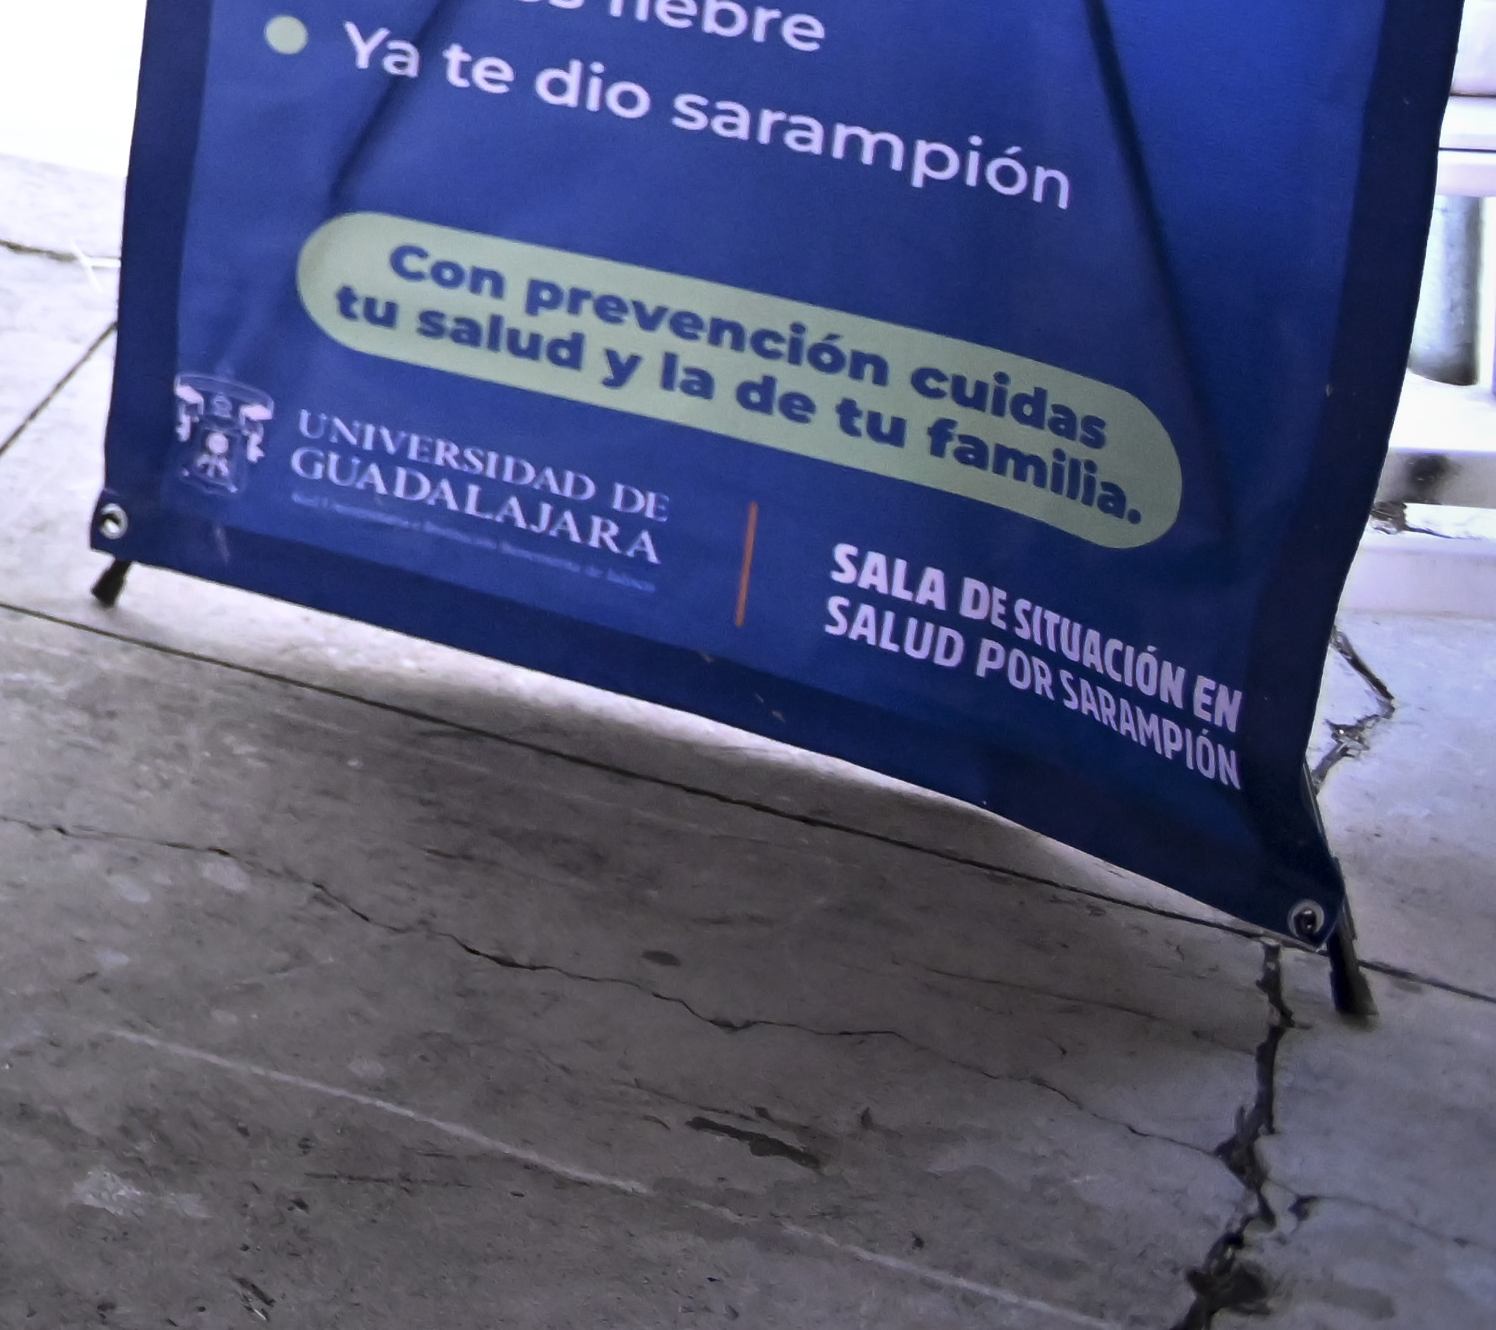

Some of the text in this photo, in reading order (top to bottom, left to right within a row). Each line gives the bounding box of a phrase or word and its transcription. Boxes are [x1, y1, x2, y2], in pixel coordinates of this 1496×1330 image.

[345, 22, 1072, 210] Ya te dio sarampión
[336, 282, 1143, 526] tu salud y la de tu familia.
[389, 243, 1107, 448] Con prevención cuidas
[291, 446, 661, 564] GUADALAJARA
[298, 409, 670, 522] UNIVERSIDAD DE
[825, 595, 1242, 794] SALUD POR SARAMPIÓN
[830, 542, 1242, 731] SALA DE SITUACIÓN EN
